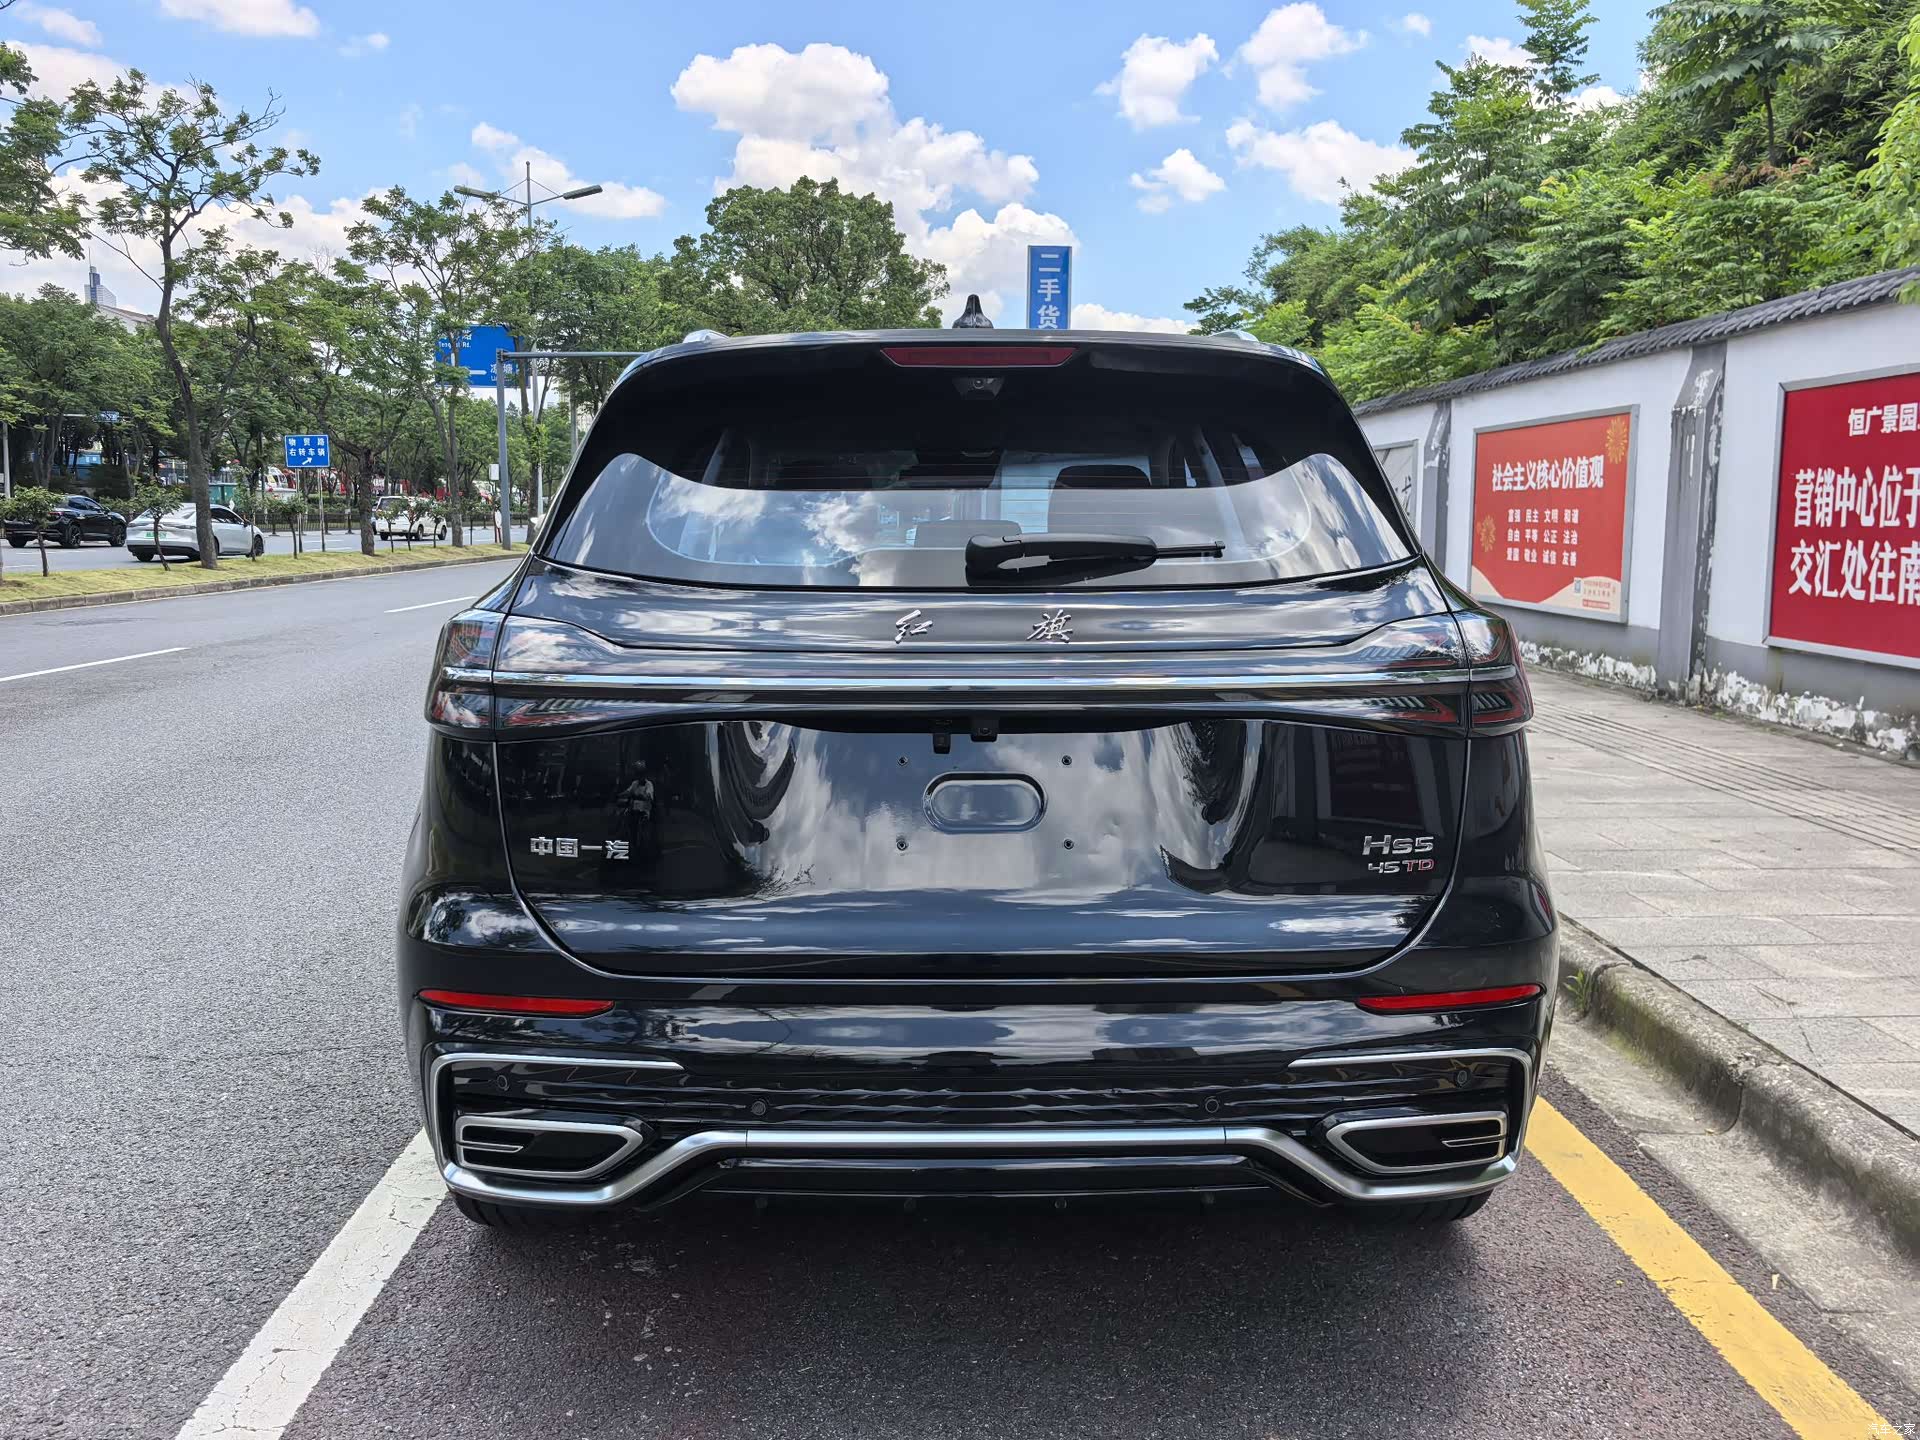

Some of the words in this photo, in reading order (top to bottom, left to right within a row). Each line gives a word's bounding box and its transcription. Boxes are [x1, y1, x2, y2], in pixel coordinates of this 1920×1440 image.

[1037, 252, 1061, 329] 二手货
[1848, 402, 1920, 437] 恒广景园
[289, 448, 326, 456] 右转车辆
[1492, 454, 1605, 492] 社会主义核心价值观
[1794, 464, 1920, 528] 营销中心位于
[1525, 508, 1539, 523] 民主
[1544, 508, 1559, 524] 文明
[1507, 528, 1520, 542] 自由
[1525, 528, 1538, 543] 平等
[1543, 529, 1558, 544] 公正
[1563, 529, 1578, 545] 法治
[1788, 538, 1920, 606] 交汇处往南
[530, 836, 630, 860] 中国一汽
[1362, 835, 1434, 855] HS5
[1368, 859, 1435, 874] 45TD
